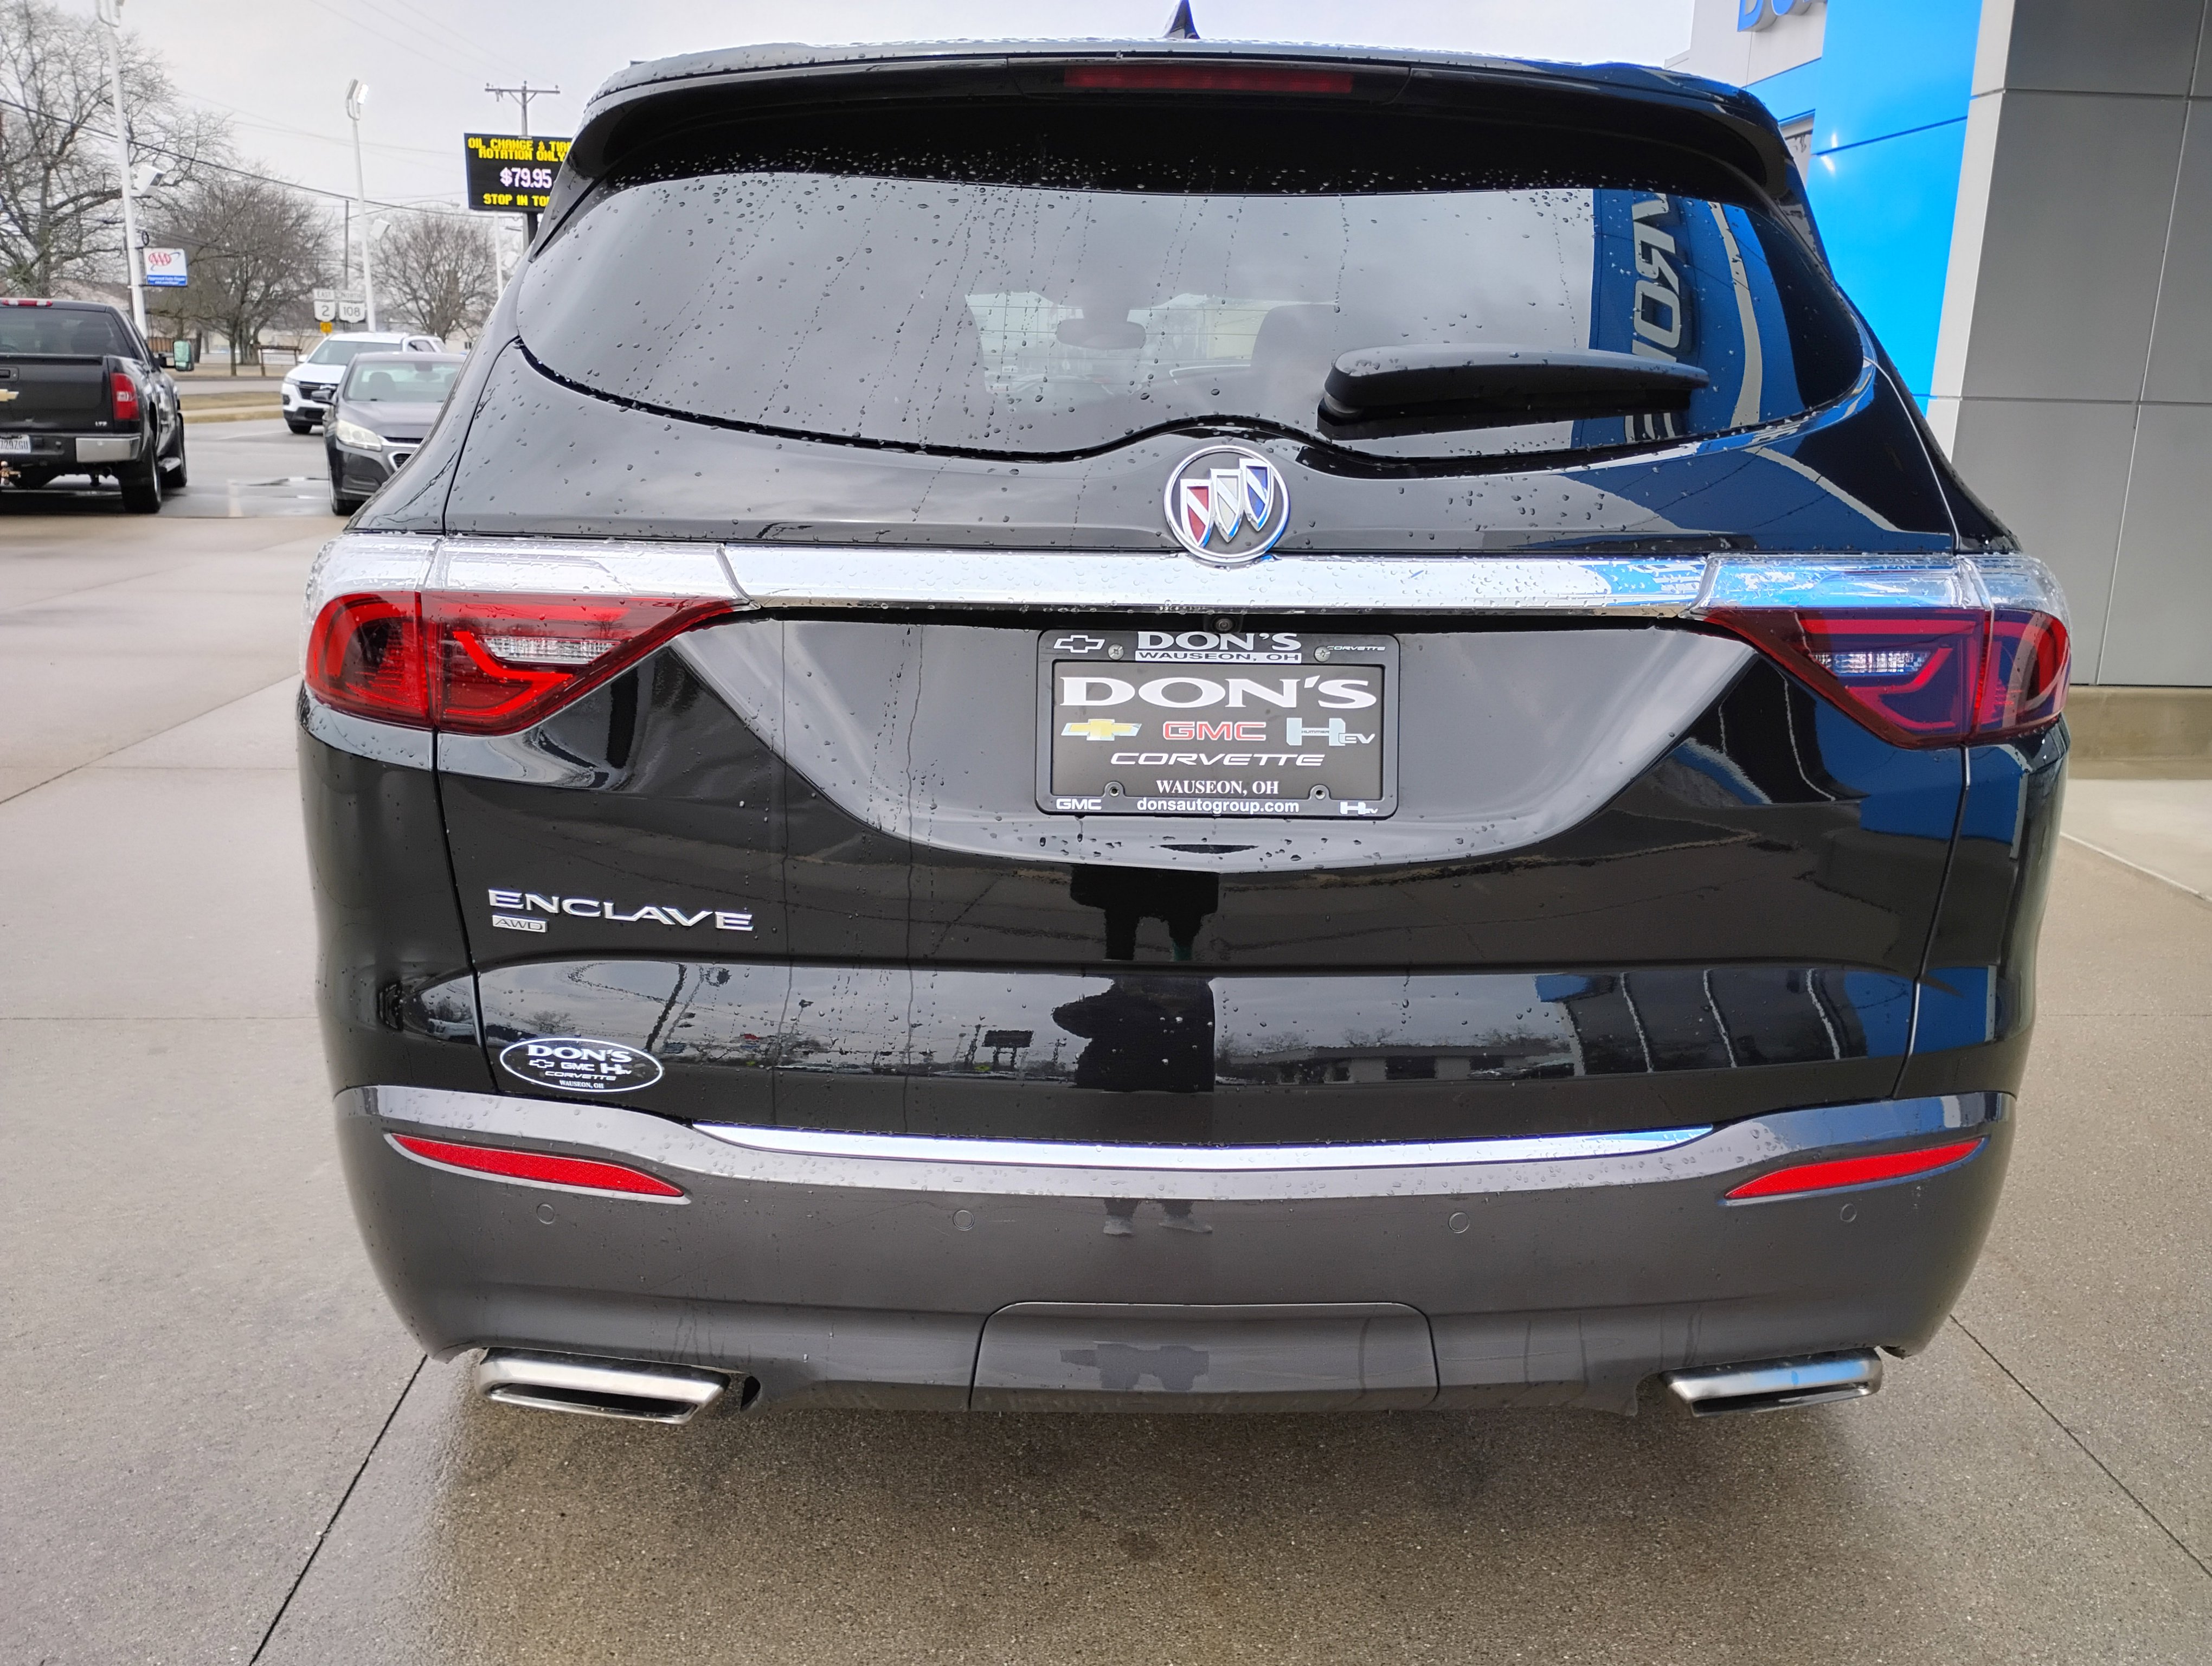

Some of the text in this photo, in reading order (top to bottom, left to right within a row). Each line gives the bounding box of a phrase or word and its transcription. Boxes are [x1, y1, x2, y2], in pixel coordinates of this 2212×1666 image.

[468, 138, 486, 149] OIL
[490, 138, 533, 151] CHANGE
[478, 148, 532, 161] ROTATION
[500, 167, 552, 188] $79.95
[483, 193, 513, 205] STOP
[517, 194, 528, 206] IN
[149, 252, 171, 266] AAA
[321, 305, 330, 317] 2
[343, 306, 361, 317] 108
[1137, 631, 1301, 651] DON'S
[1139, 652, 1257, 662] WAUSEON,
[1059, 675, 1377, 709] DON'S
[1162, 721, 1266, 741] GMC
[1110, 752, 1325, 766] CORVETTE
[1156, 780, 1279, 796] WAUSEON, OH
[1056, 798, 1102, 810] GMC
[1137, 798, 1300, 815] donsautogroup.com
[488, 889, 754, 931] ENCLAVE
[496, 918, 544, 931] AWD
[528, 1045, 632, 1063] DON'S
[561, 1062, 595, 1071] GMC
[545, 1071, 616, 1081] CORVETTE
[559, 1080, 593, 1089] WAUSEON,
